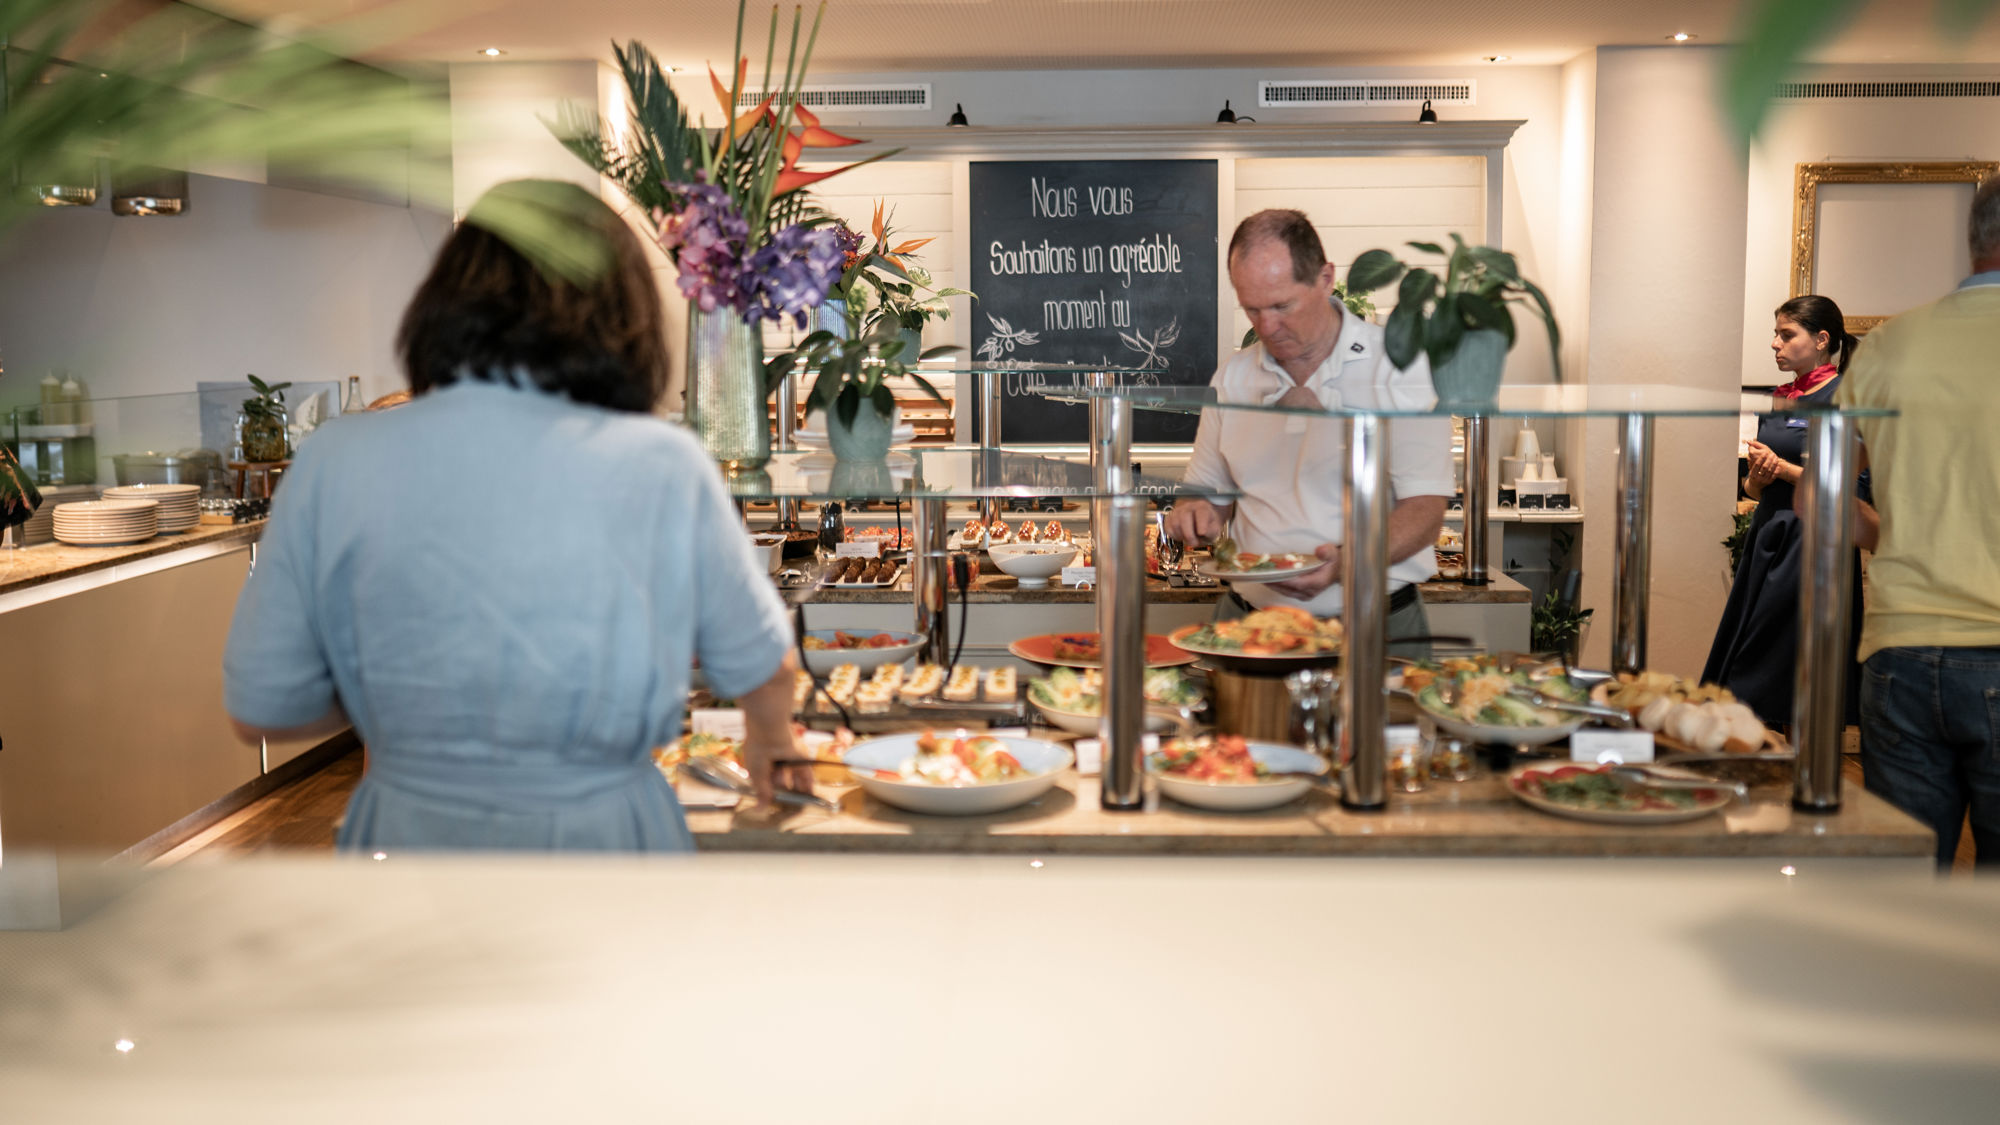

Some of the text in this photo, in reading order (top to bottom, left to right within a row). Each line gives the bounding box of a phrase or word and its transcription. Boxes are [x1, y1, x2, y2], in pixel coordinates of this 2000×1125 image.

[1032, 177, 1133, 218] Nous vous
[990, 233, 1183, 288] Souhaitons un agréable
[1044, 290, 1131, 331] moment au
